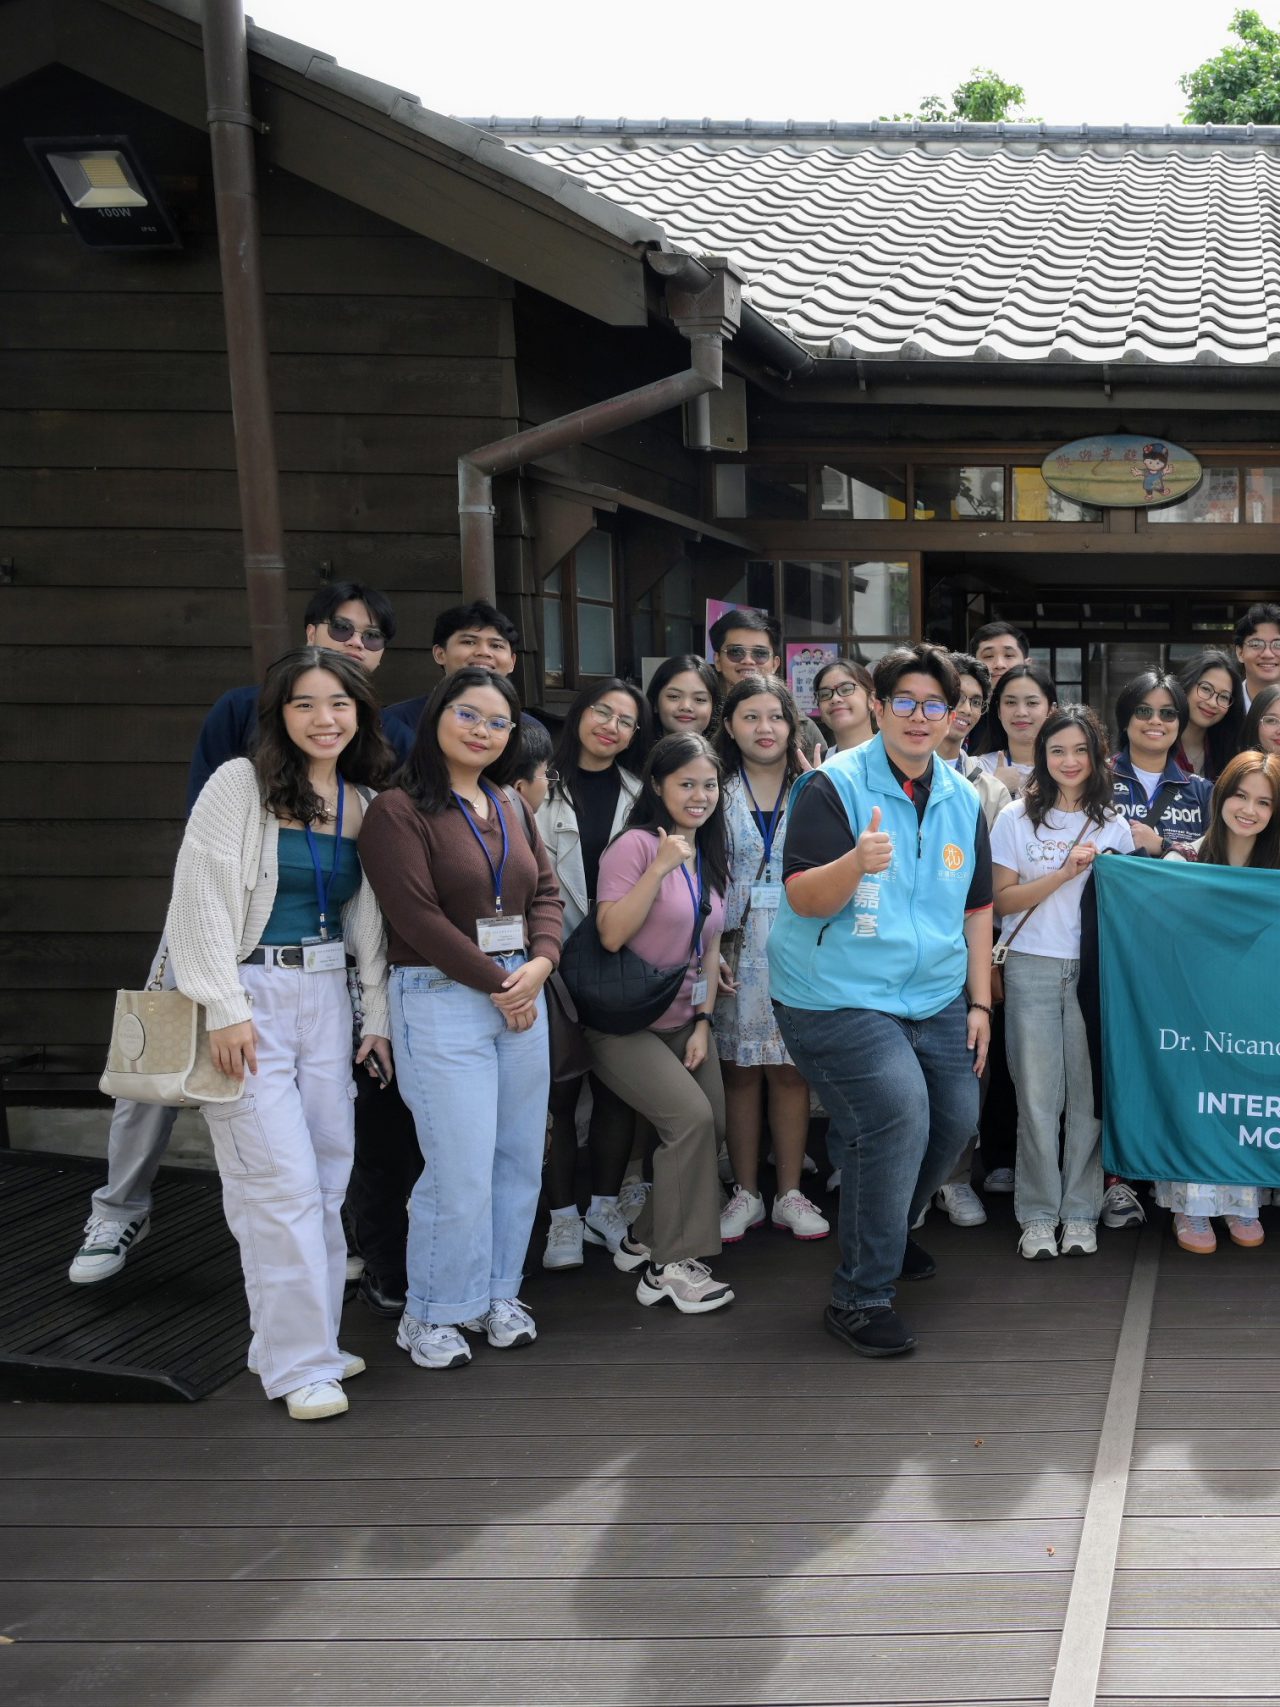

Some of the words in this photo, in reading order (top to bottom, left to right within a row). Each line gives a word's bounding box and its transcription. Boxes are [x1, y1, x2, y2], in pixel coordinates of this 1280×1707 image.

[97, 208, 131, 217] 100W
[1113, 804, 1148, 818] ove
[851, 874, 881, 938] 嘉彥
[1159, 1028, 1196, 1051] Dr.
